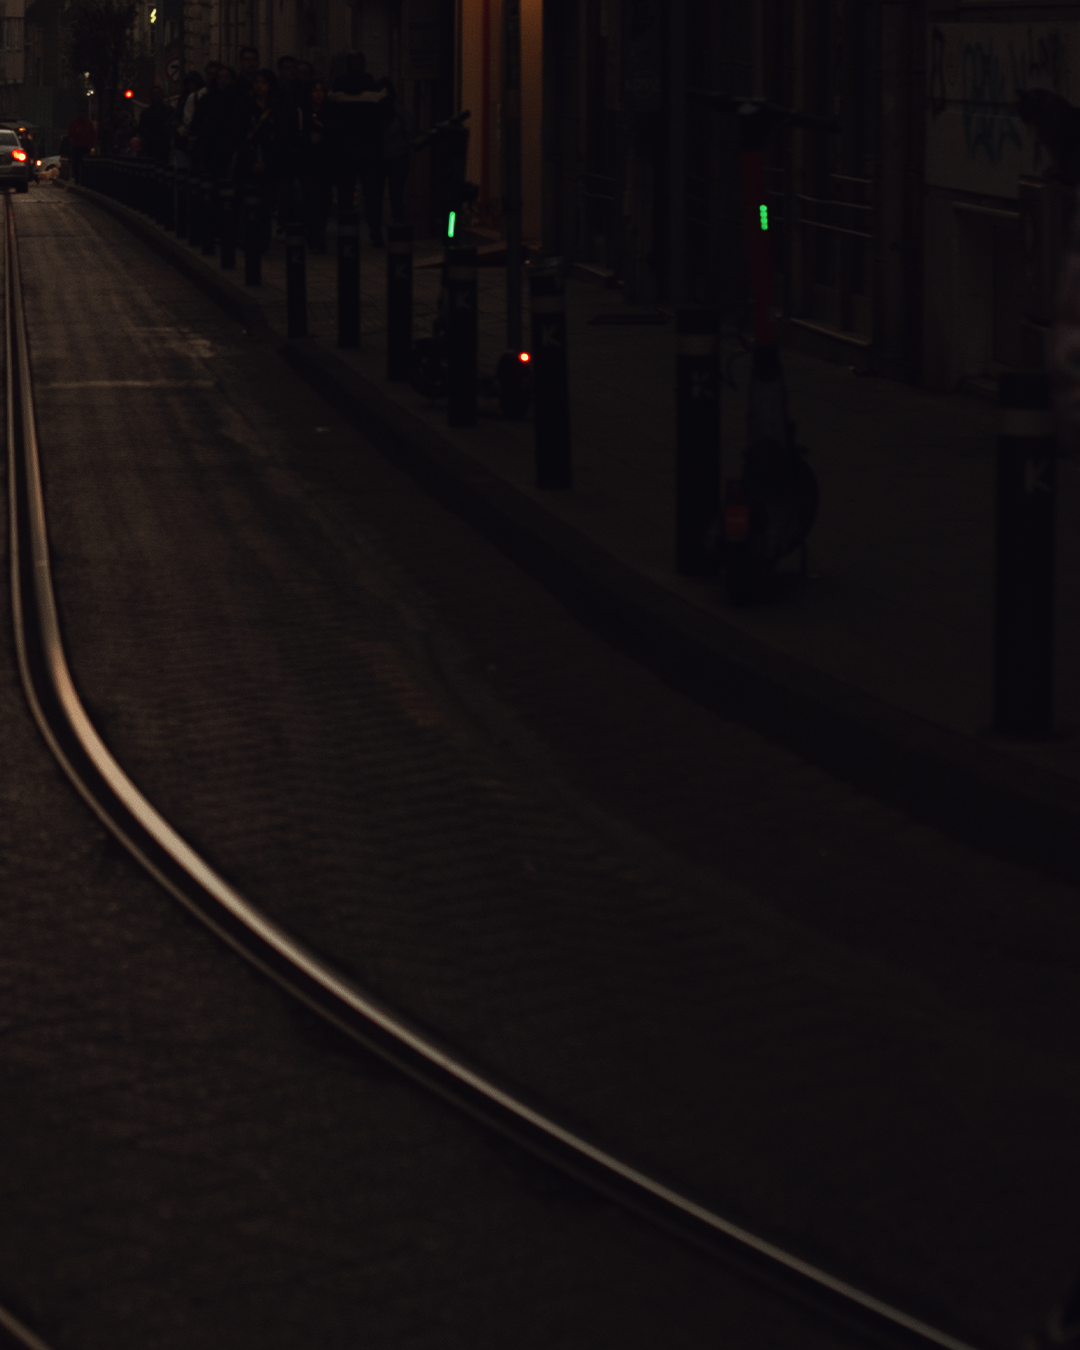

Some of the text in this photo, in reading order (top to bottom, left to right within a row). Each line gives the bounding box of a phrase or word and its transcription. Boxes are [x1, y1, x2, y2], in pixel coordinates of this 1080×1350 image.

[394, 262, 409, 280] K
[455, 290, 472, 310] K
[541, 324, 563, 347] K
[690, 369, 716, 399] K
[1024, 457, 1054, 495] K
